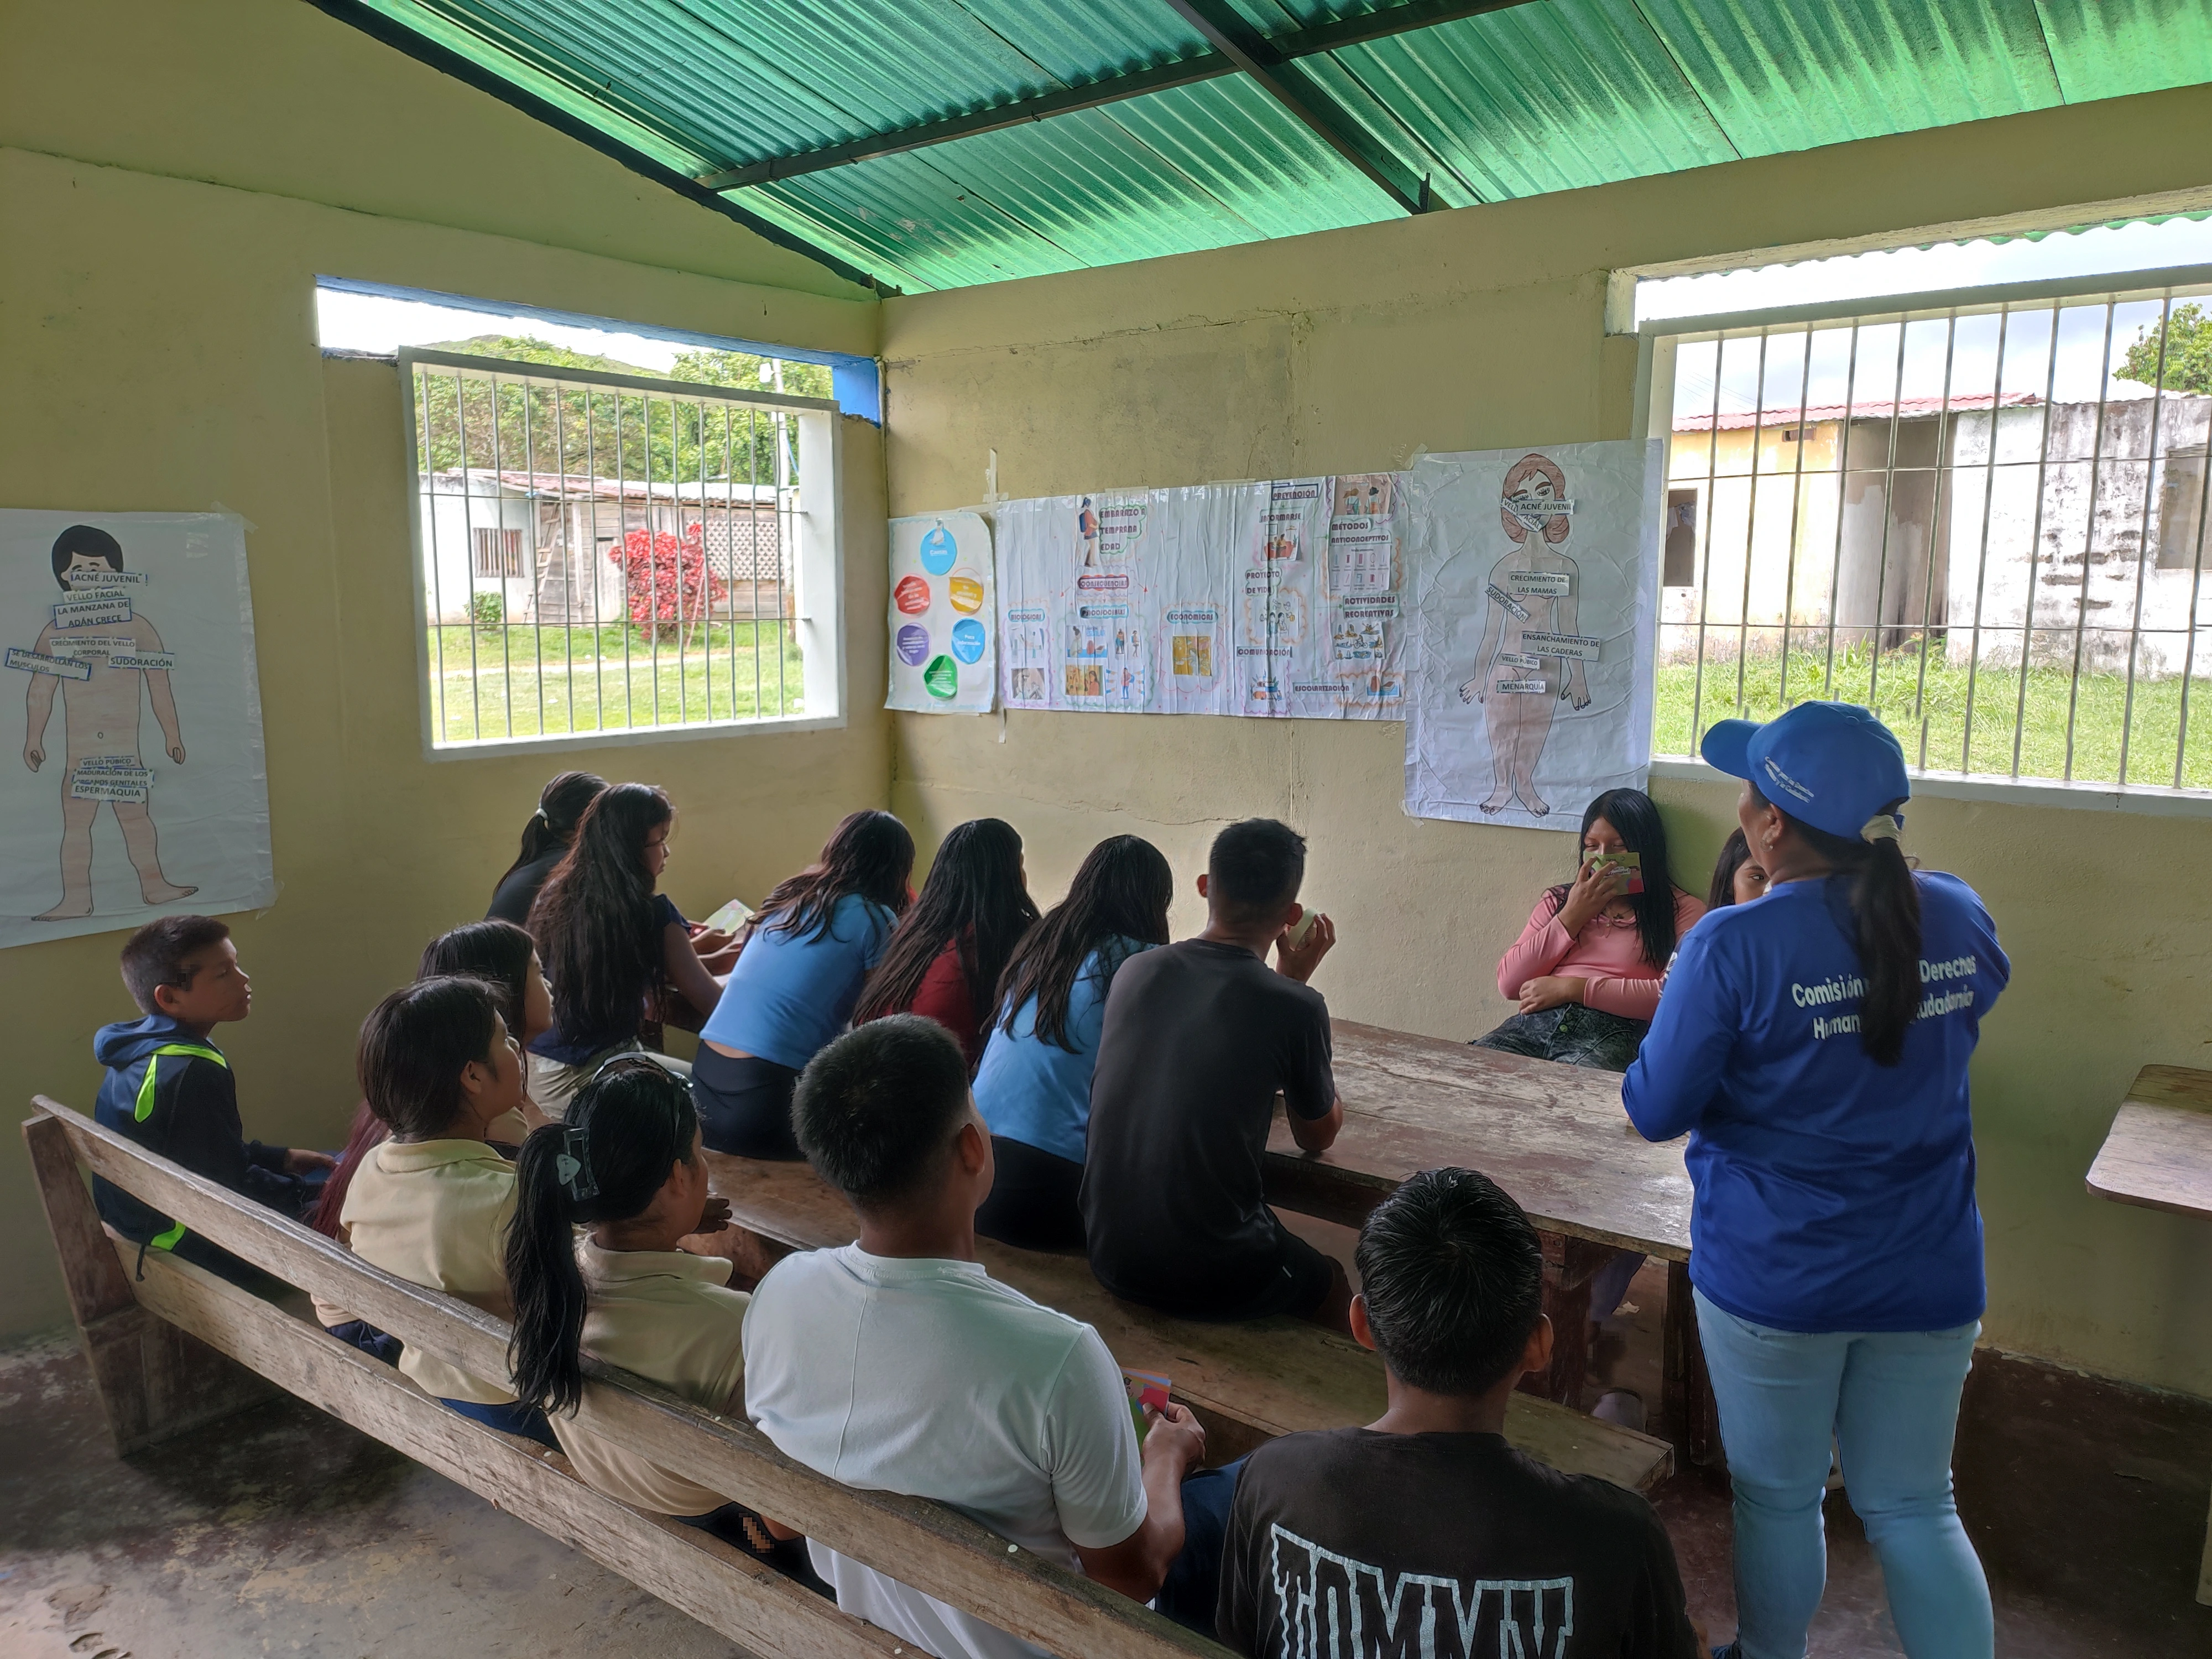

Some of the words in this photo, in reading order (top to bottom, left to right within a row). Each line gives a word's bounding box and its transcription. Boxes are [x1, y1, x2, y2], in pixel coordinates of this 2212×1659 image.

[1273, 489, 1315, 499] PREVENCIÓN
[1504, 499, 1518, 513] VELL
[1100, 509, 1139, 518] EMBARAZO
[1100, 525, 1137, 534] TEMPRANA
[1332, 535, 1389, 543] ANTICONCEPTIVOS
[75, 573, 100, 582] ACNÉ
[102, 575, 140, 583] JUVENIL
[66, 592, 92, 601] VELLO
[95, 590, 124, 598] FACIAL
[1345, 596, 1395, 604] ACTIVIDADES
[70, 603, 116, 613] MANZANA
[1486, 586, 1526, 621] SUDORACIÓN
[1345, 609, 1394, 618] RECREATIVAS
[69, 617, 93, 627] ADÁN
[96, 615, 122, 624] CRECE
[1522, 634, 1588, 646] ENSANCHAMIENTO
[1551, 648, 1583, 656] CADERAS
[111, 657, 173, 667] SUDORACIÓN
[1502, 682, 1545, 691] MENARQUÍA
[1792, 973, 1864, 1008] Comisión
